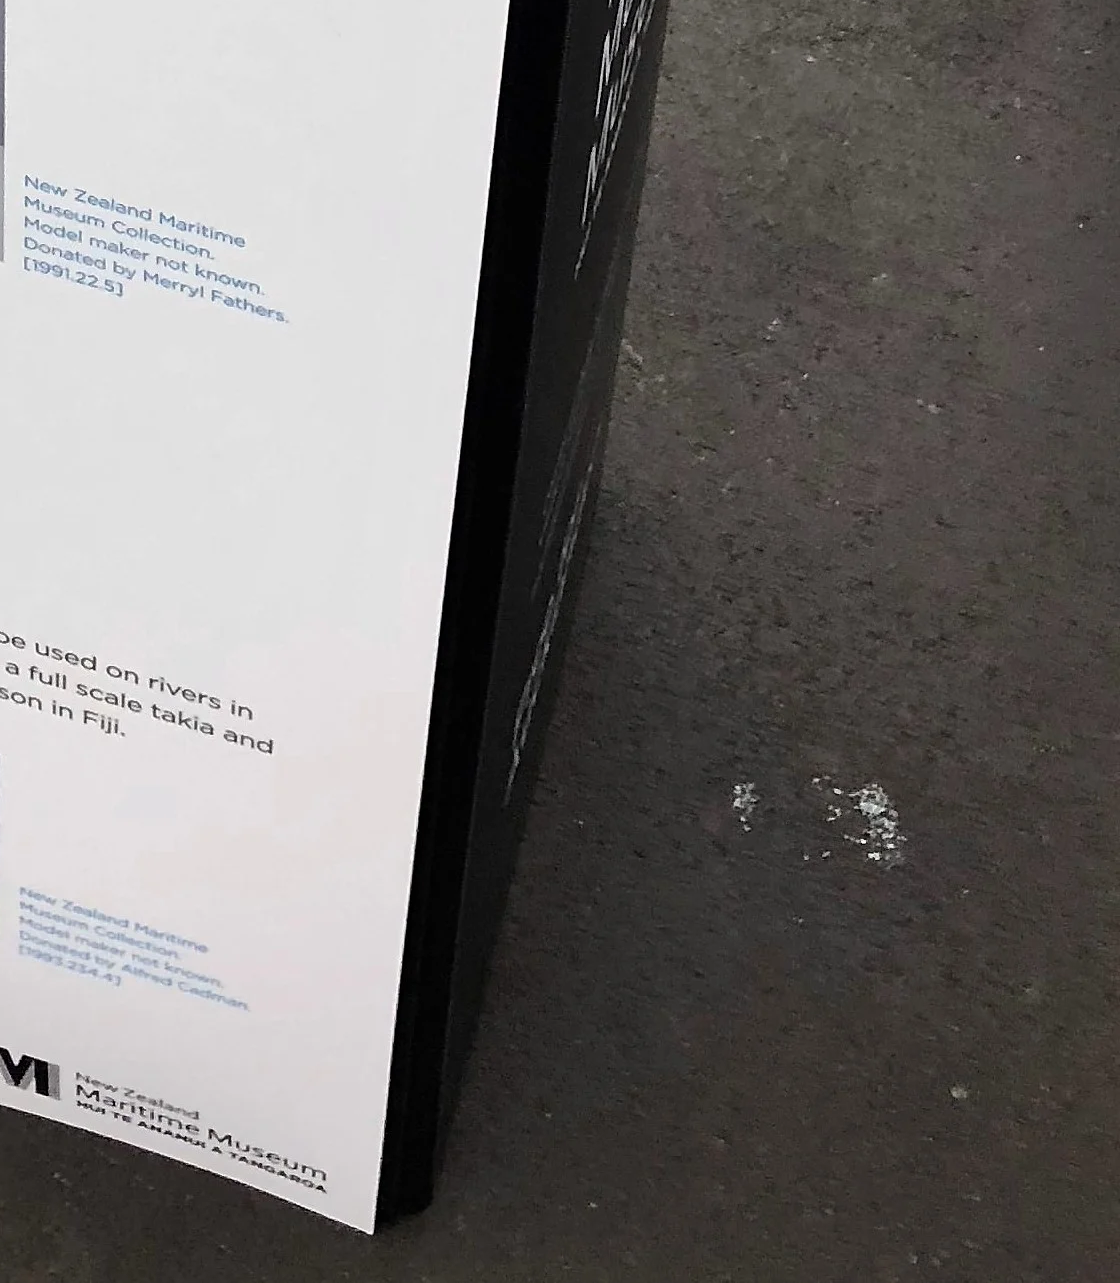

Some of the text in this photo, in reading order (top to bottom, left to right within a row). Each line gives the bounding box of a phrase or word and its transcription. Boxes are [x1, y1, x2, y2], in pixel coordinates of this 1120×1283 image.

[23, 195, 216, 260] Museum Collection.
[24, 174, 246, 249] New Zealand Maritime
[22, 255, 125, 297] [1991.22.5]
[23, 215, 265, 296] Model maker not known.
[23, 236, 291, 324] Donated by Merryl Fathers.
[4, 660, 20, 676] a
[27, 665, 68, 691] full
[75, 680, 143, 714] scale
[151, 701, 215, 737] takia
[222, 725, 274, 755] and
[33, 639, 98, 672] used
[105, 663, 140, 686] on
[147, 674, 222, 711] rivers
[229, 698, 255, 721] in
[51, 699, 74, 721] in
[82, 710, 126, 738] Fiji.
[19, 901, 90, 932] Museum
[19, 886, 210, 954] New Zealand Maritime
[19, 915, 71, 940] Model
[75, 934, 126, 958] maker
[131, 951, 160, 969] not
[19, 930, 91, 962] Donated
[94, 954, 116, 970] by
[75, 1071, 200, 1121] New Zealand
[75, 1084, 327, 1182] Maritime Museum
